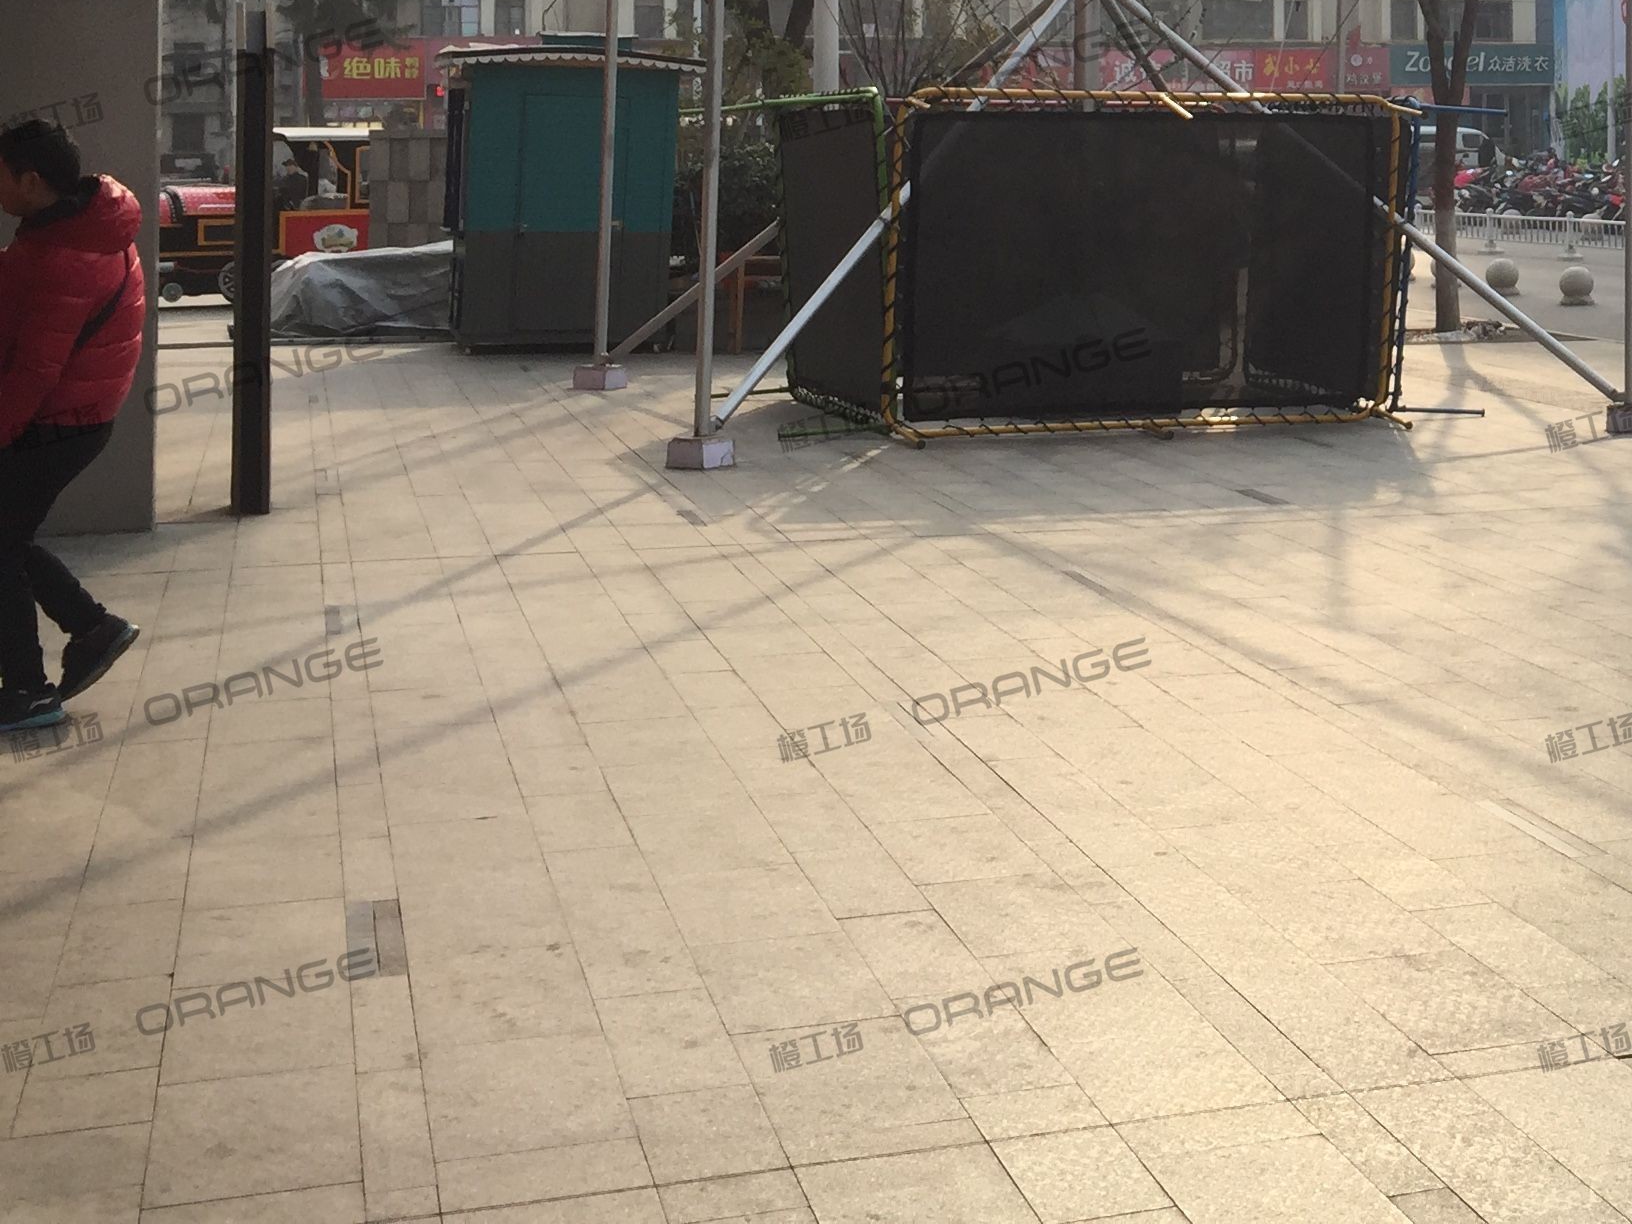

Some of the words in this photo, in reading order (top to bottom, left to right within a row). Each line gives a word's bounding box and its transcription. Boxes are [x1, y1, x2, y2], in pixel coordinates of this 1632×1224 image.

[1405, 51, 1485, 79] Zoel
[1488, 55, 1549, 72] 众洁洗衣
